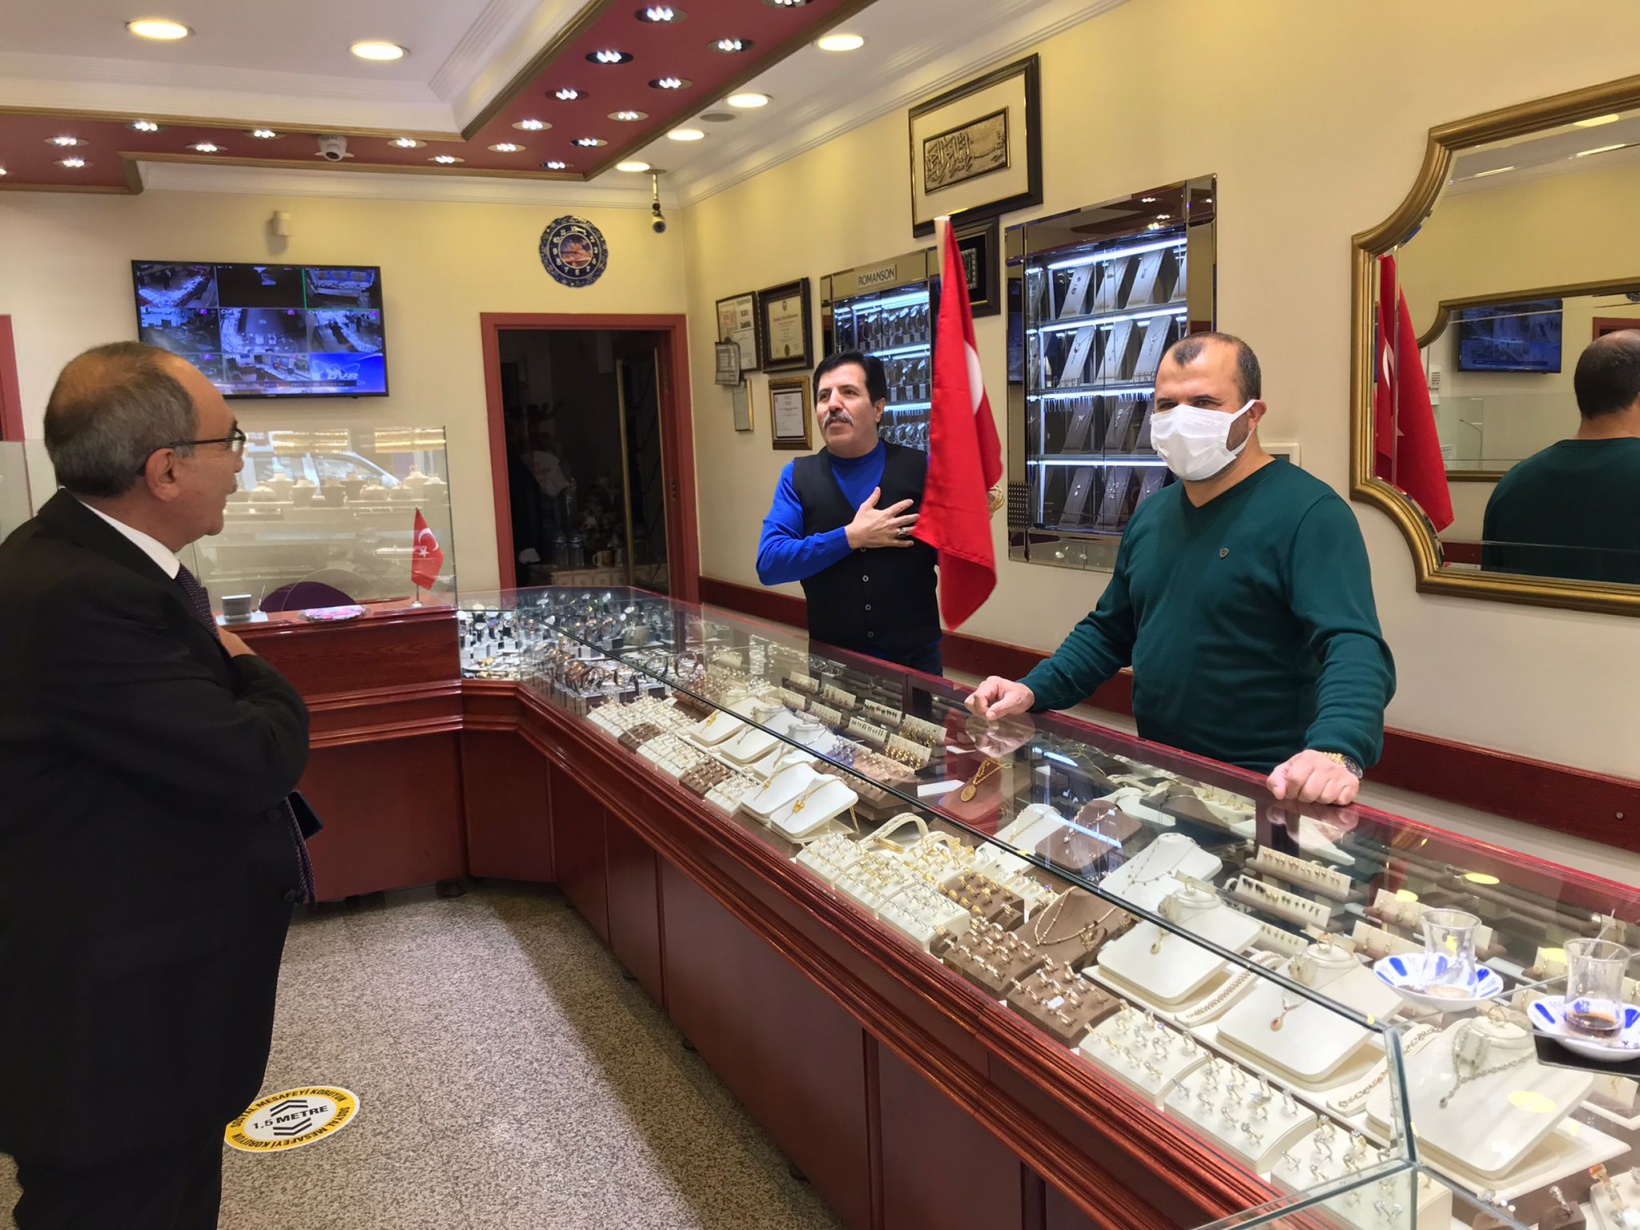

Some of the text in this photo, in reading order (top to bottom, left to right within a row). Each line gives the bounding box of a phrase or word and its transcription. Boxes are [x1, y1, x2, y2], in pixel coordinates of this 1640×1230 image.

[858, 267, 895, 287] ROMANSON
[253, 1105, 329, 1130] 1.5 METRE
